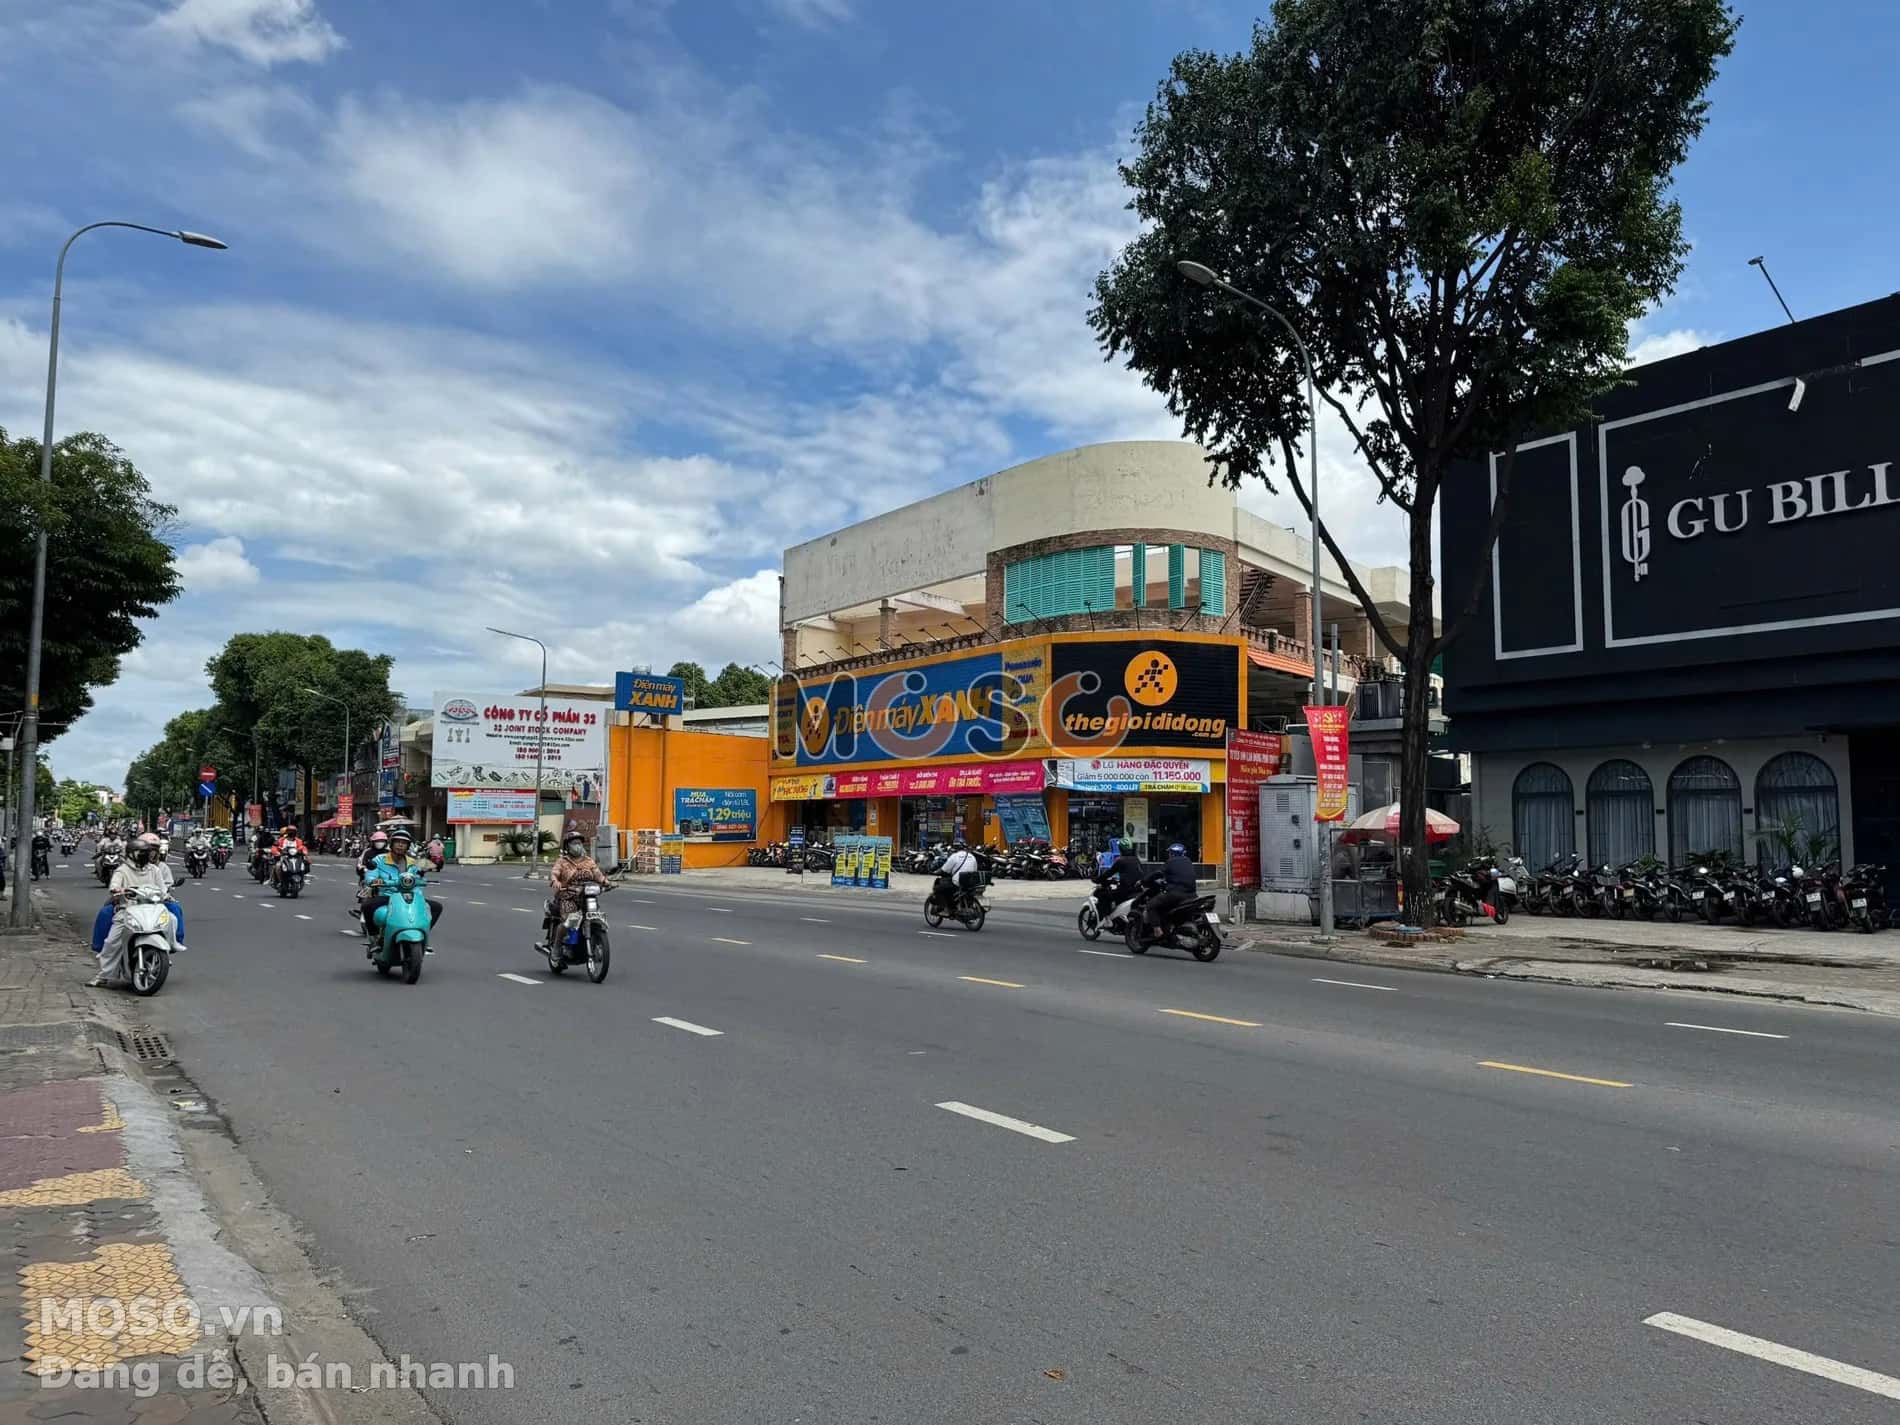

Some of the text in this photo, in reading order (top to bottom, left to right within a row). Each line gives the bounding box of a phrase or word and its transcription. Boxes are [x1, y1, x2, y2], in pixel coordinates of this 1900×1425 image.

[1667, 489, 1752, 539] GU
[628, 690, 678, 708] XANH
[484, 705, 515, 721] CÔNG
[519, 709, 533, 721] TY
[583, 713, 597, 725] 32
[876, 698, 921, 734] máy
[917, 686, 993, 725] XANH
[504, 725, 525, 734] JOINT
[527, 726, 551, 734] STOCK
[553, 727, 587, 736] COMPANY
[1064, 712, 1226, 738] thegioididong
[1103, 761, 1114, 769] LG
